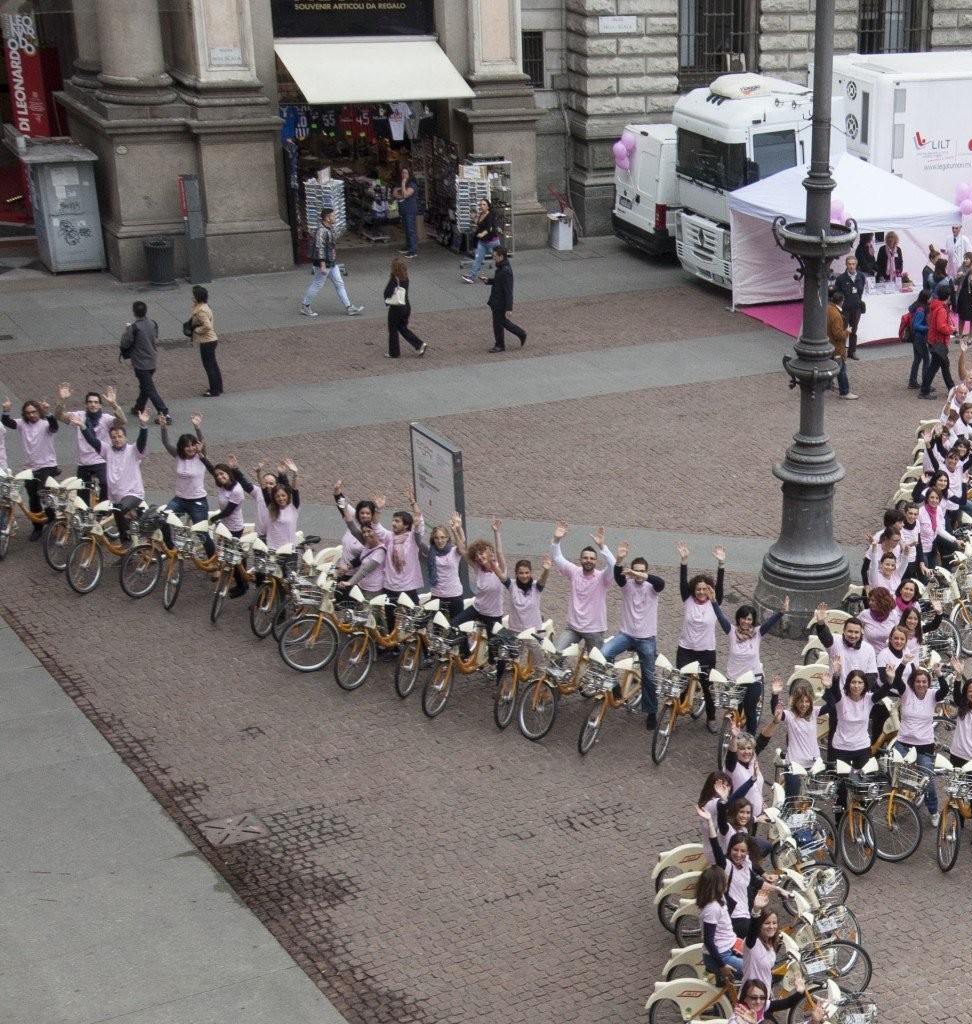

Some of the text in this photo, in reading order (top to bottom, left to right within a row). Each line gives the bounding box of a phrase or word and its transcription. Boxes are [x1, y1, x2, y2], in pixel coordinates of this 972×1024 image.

[294, 3, 332, 11] SOUVENIR
[378, 2, 407, 10] REGALO
[8, 38, 29, 116] LEONARDO
[18, 117, 31, 132] DI
[931, 139, 951, 150] LILT
